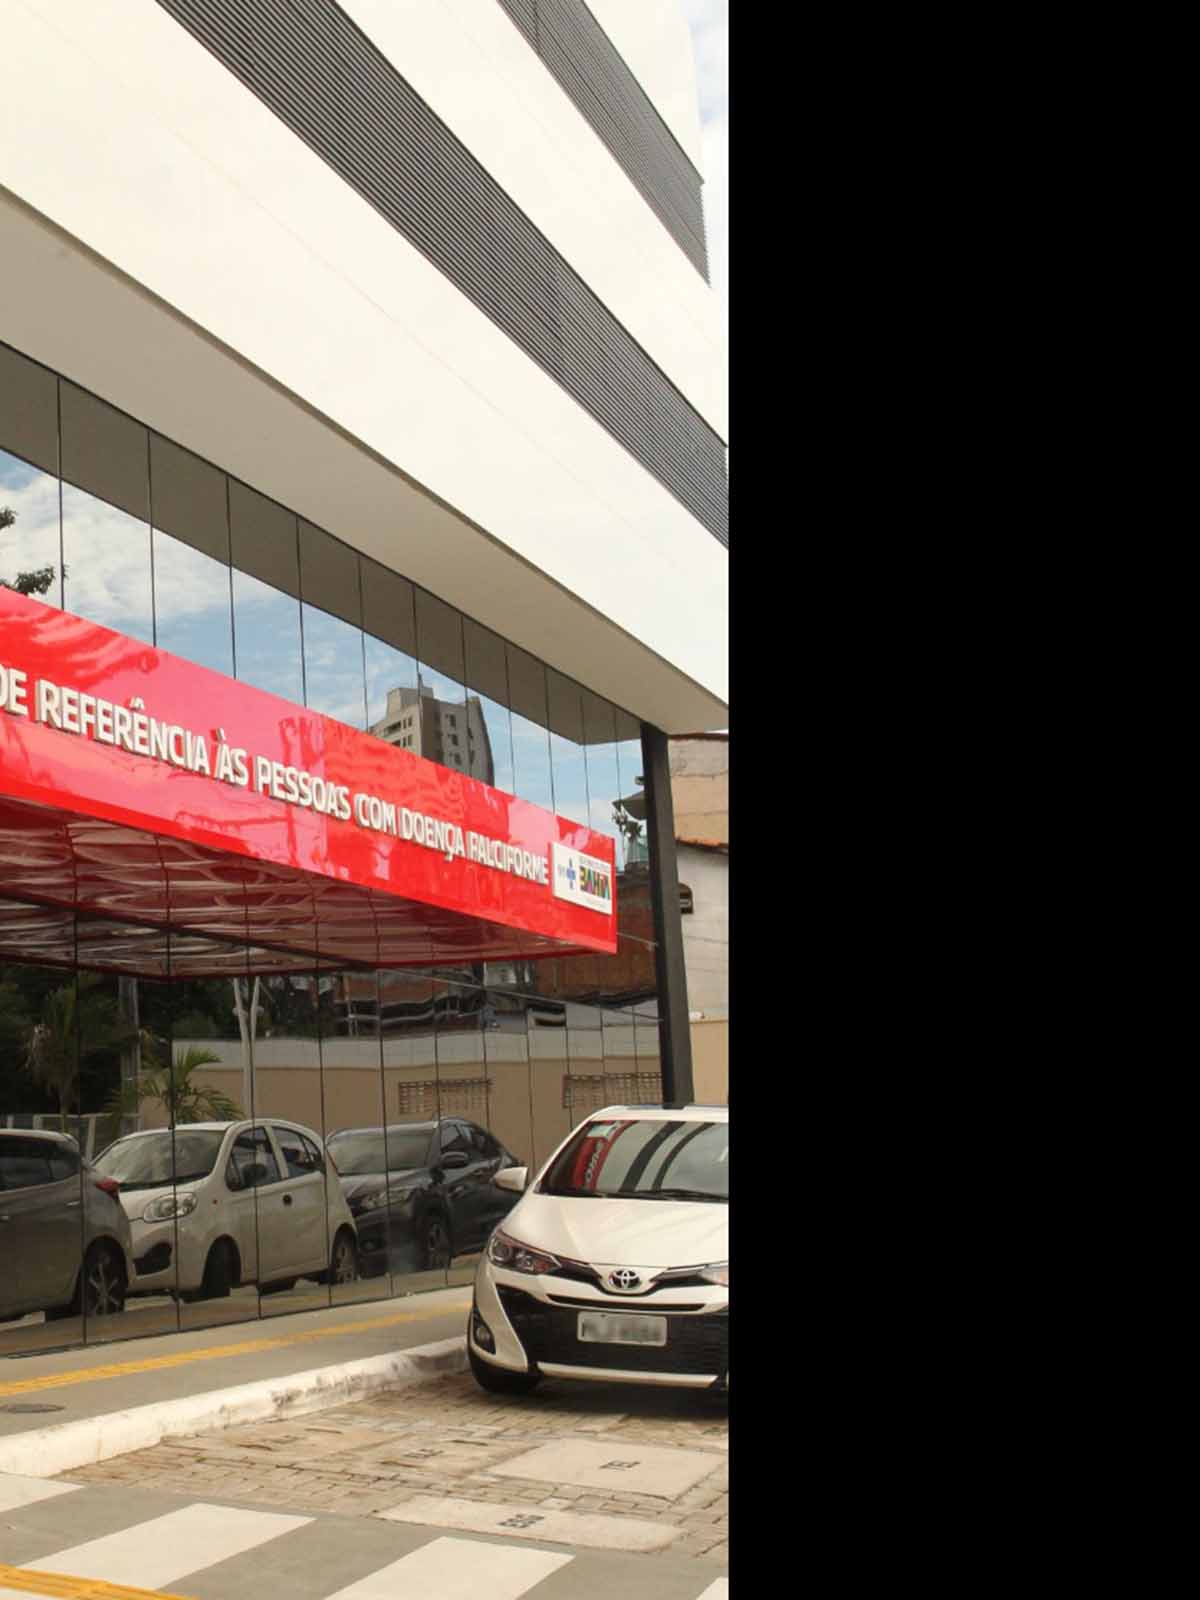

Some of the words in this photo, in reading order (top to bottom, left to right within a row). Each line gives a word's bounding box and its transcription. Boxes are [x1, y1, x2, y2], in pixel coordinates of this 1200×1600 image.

[35, 678, 211, 776] REFERÊNCIA
[213, 728, 250, 787] ÀS
[254, 755, 352, 822] PESSOAS
[354, 793, 397, 836] COM
[400, 806, 466, 862] DOENÇA
[467, 831, 549, 886] FALCIFORME
